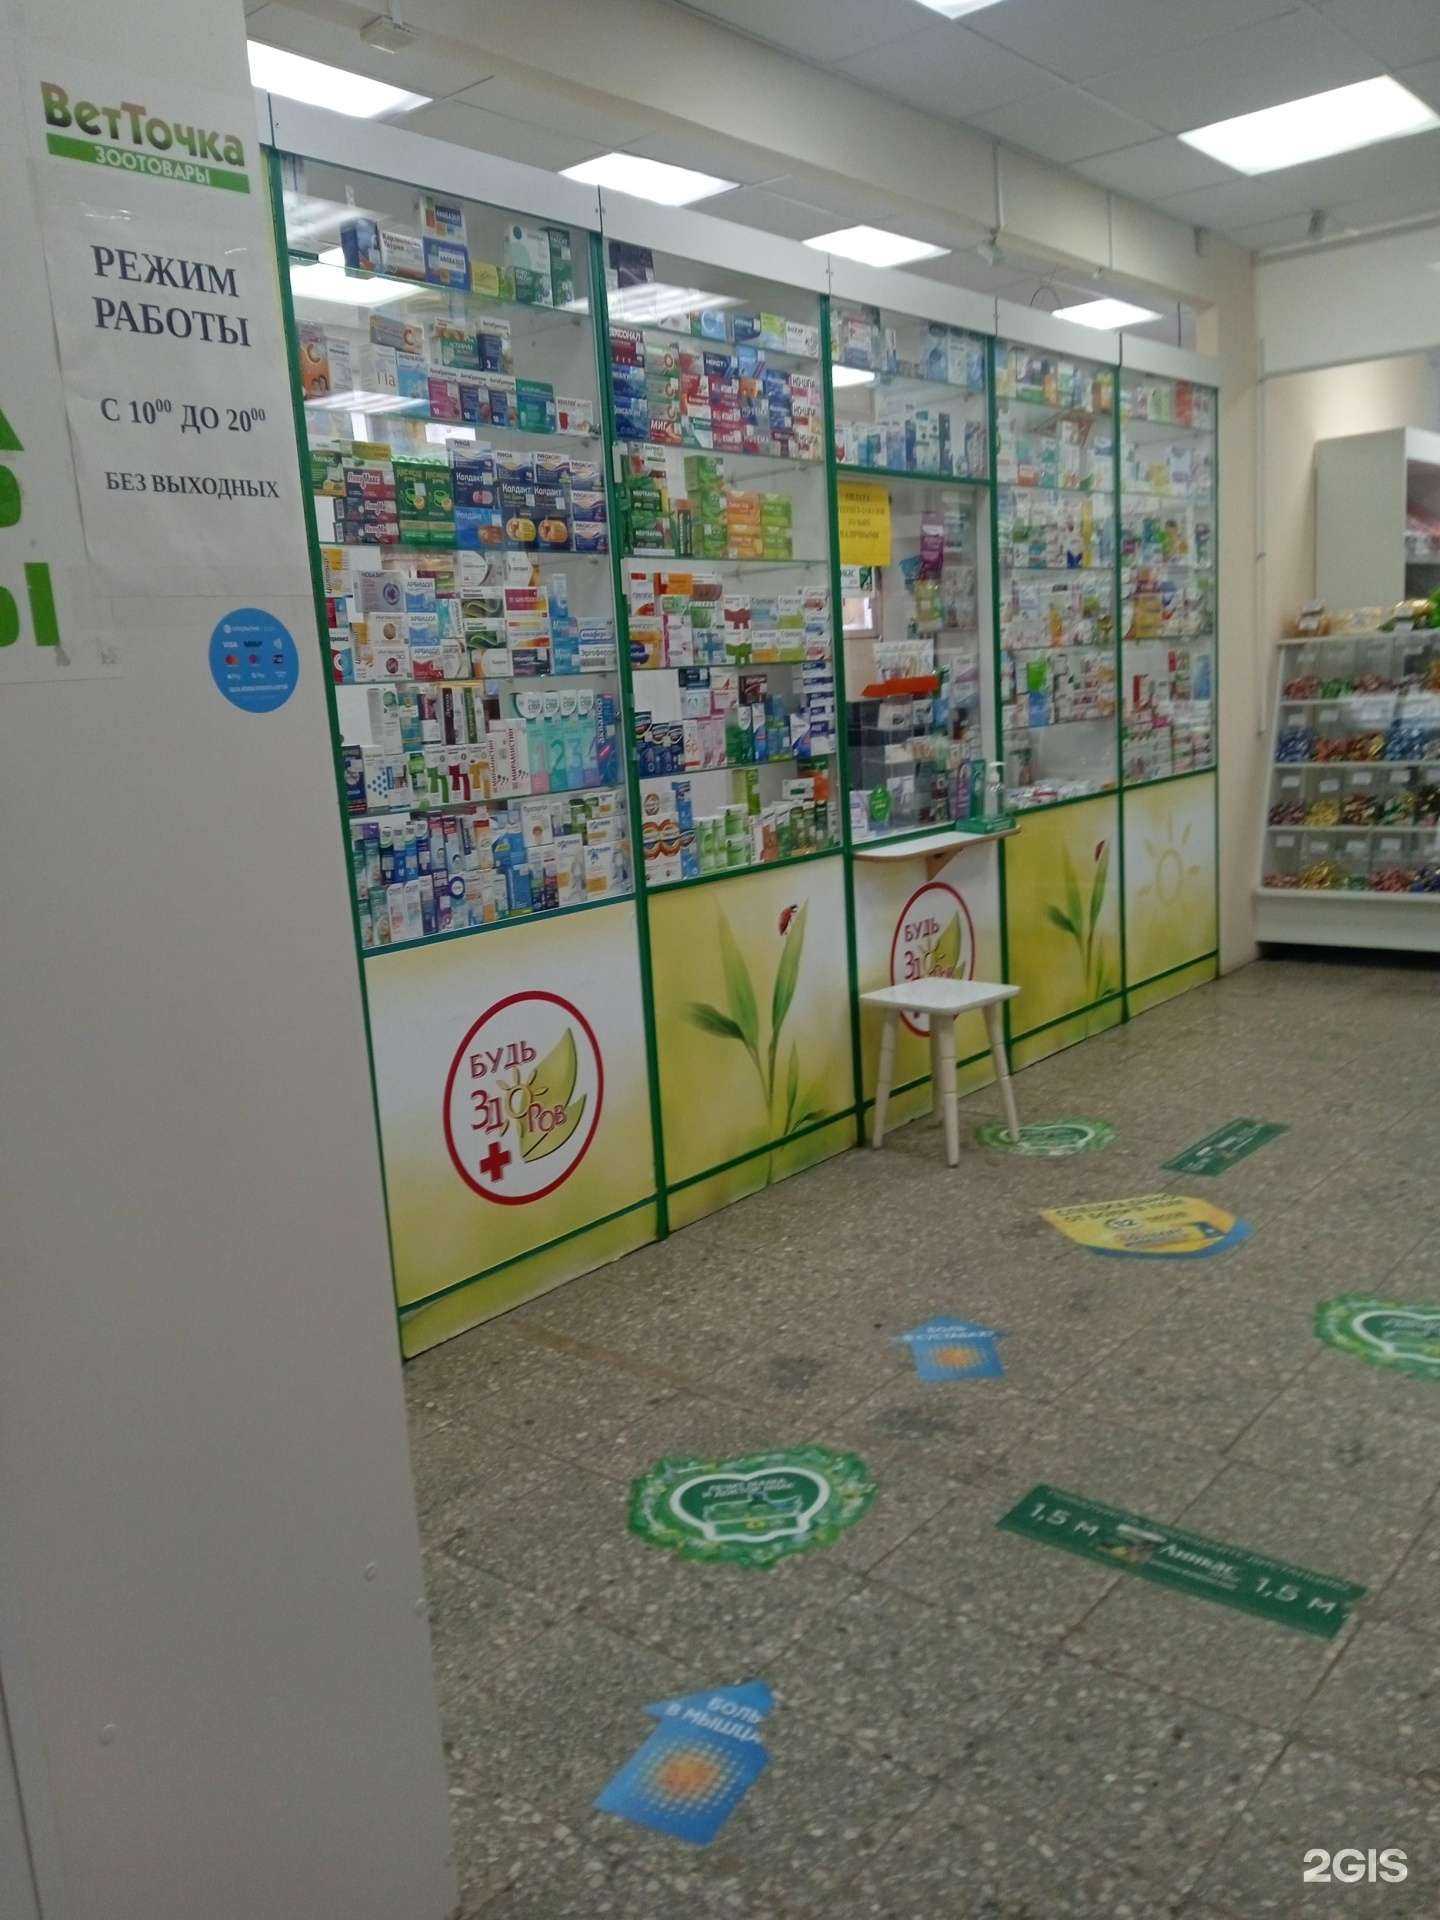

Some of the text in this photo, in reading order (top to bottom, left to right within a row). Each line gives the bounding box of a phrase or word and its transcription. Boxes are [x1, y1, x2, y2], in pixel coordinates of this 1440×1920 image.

[40, 80, 246, 168] ВетТочка
[94, 145, 211, 186] ЗООТОВАРЫ
[90, 244, 240, 298] РЕЖИМ
[91, 296, 252, 347] РАБОТЫ
[101, 397, 119, 422] С
[181, 404, 219, 434] ДО
[104, 472, 280, 500] БЕЗ ВЫХОДНЫХ
[502, 483, 532, 496] Колдакт
[533, 484, 564, 497] Колдакт
[904, 916, 940, 943] БУДЬ
[469, 1040, 537, 1080] БУДЬ
